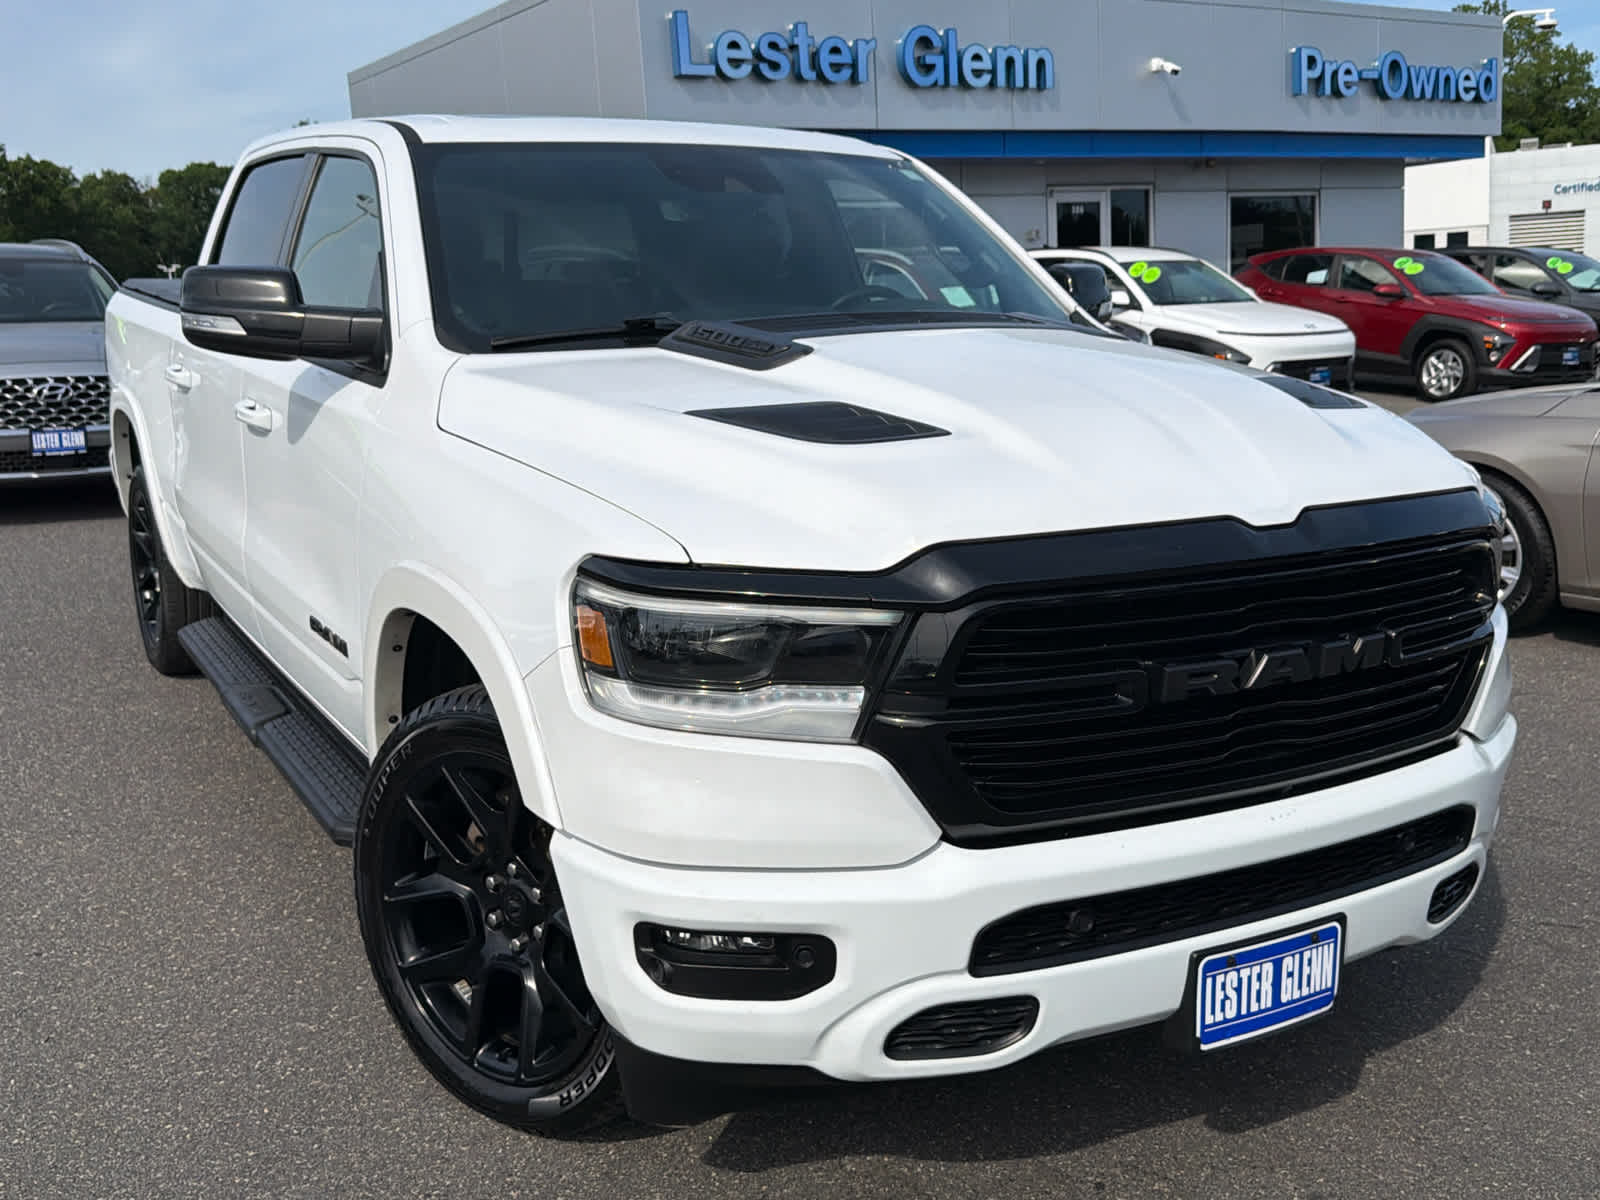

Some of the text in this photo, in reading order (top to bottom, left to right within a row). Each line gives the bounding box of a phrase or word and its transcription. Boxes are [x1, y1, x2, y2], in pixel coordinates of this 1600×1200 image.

[669, 9, 1055, 89] Lester Glenn
[1291, 46, 1497, 102] Pre-Owned
[33, 430, 86, 449] LESTER GLENN
[1160, 632, 1388, 703] RAM
[1204, 942, 1335, 1025] LESTER GLENN
